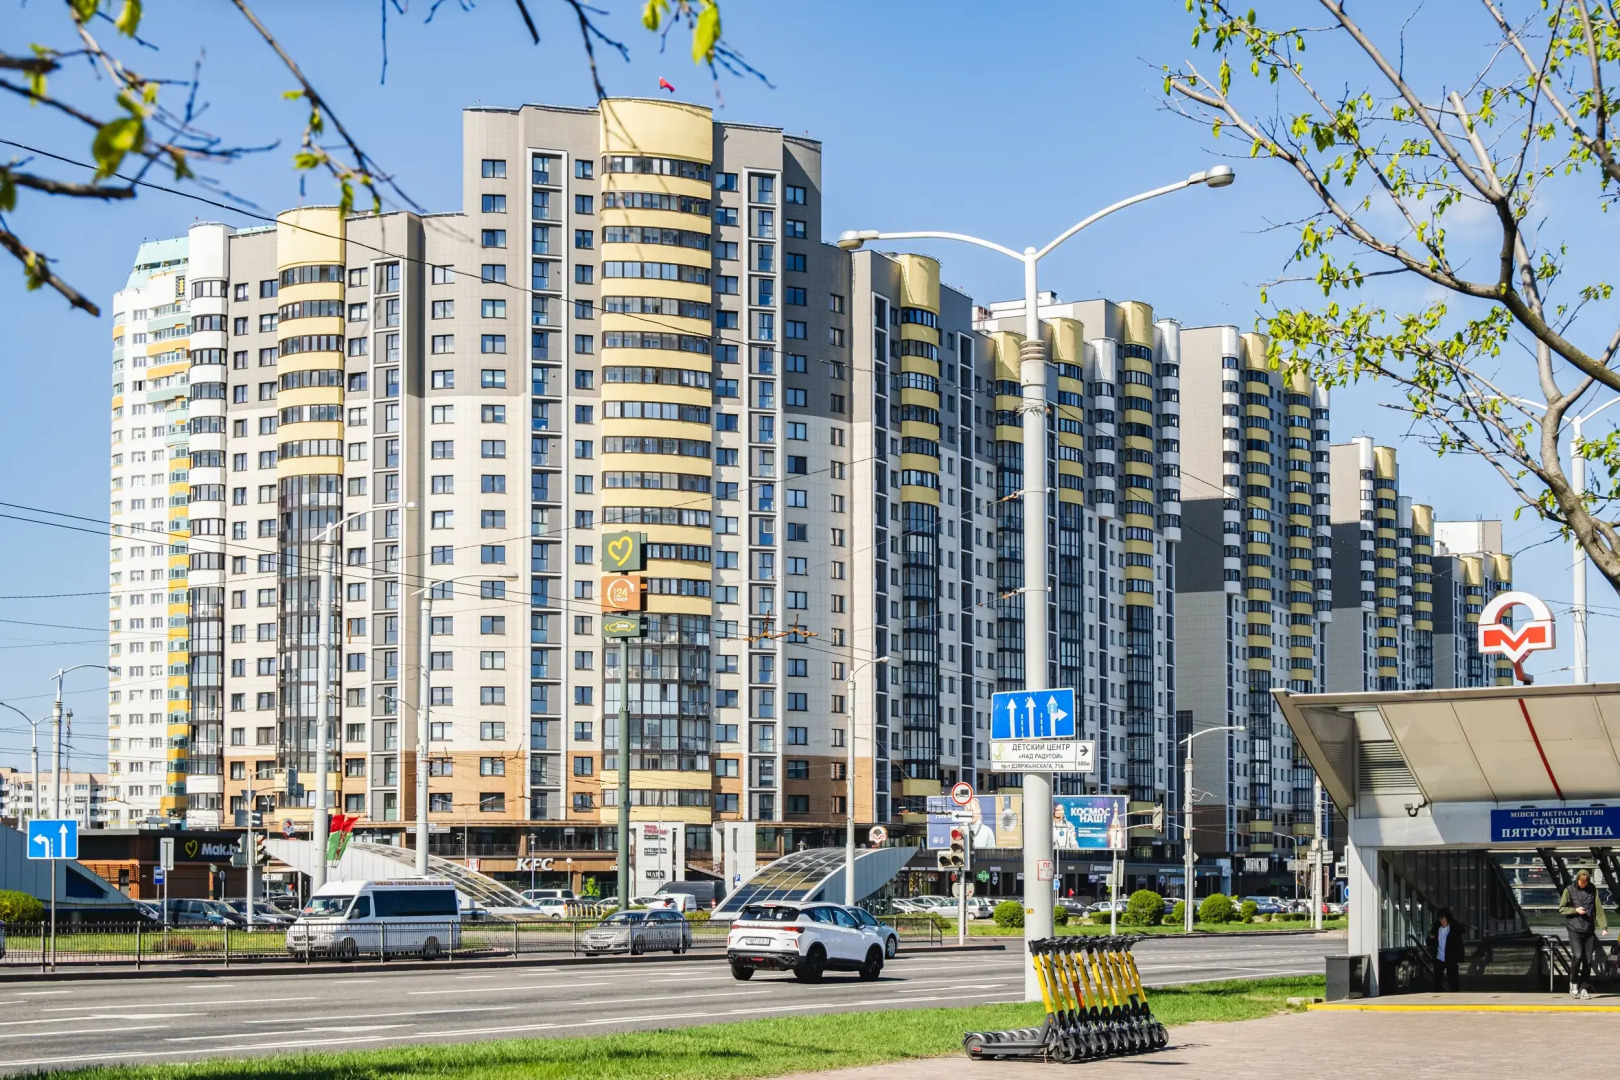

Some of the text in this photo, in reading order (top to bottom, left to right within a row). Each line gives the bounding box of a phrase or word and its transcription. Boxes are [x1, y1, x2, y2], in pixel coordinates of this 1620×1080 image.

[616, 588, 628, 598] 24
[1012, 743, 1070, 751] ДЕТСКИЙ ЦЕНТР
[1034, 752, 1063, 760] РАДУГОЙ»
[1071, 807, 1111, 816] КОСМОС
[1541, 809, 1604, 817] МЕТРАПАЛІТЭН
[1079, 814, 1107, 823] НАШ!
[1532, 817, 1582, 825] СТАНЦЫЯ
[1501, 825, 1614, 838] ПЯТРОЎШЧЫНА
[515, 857, 554, 871] KFC
